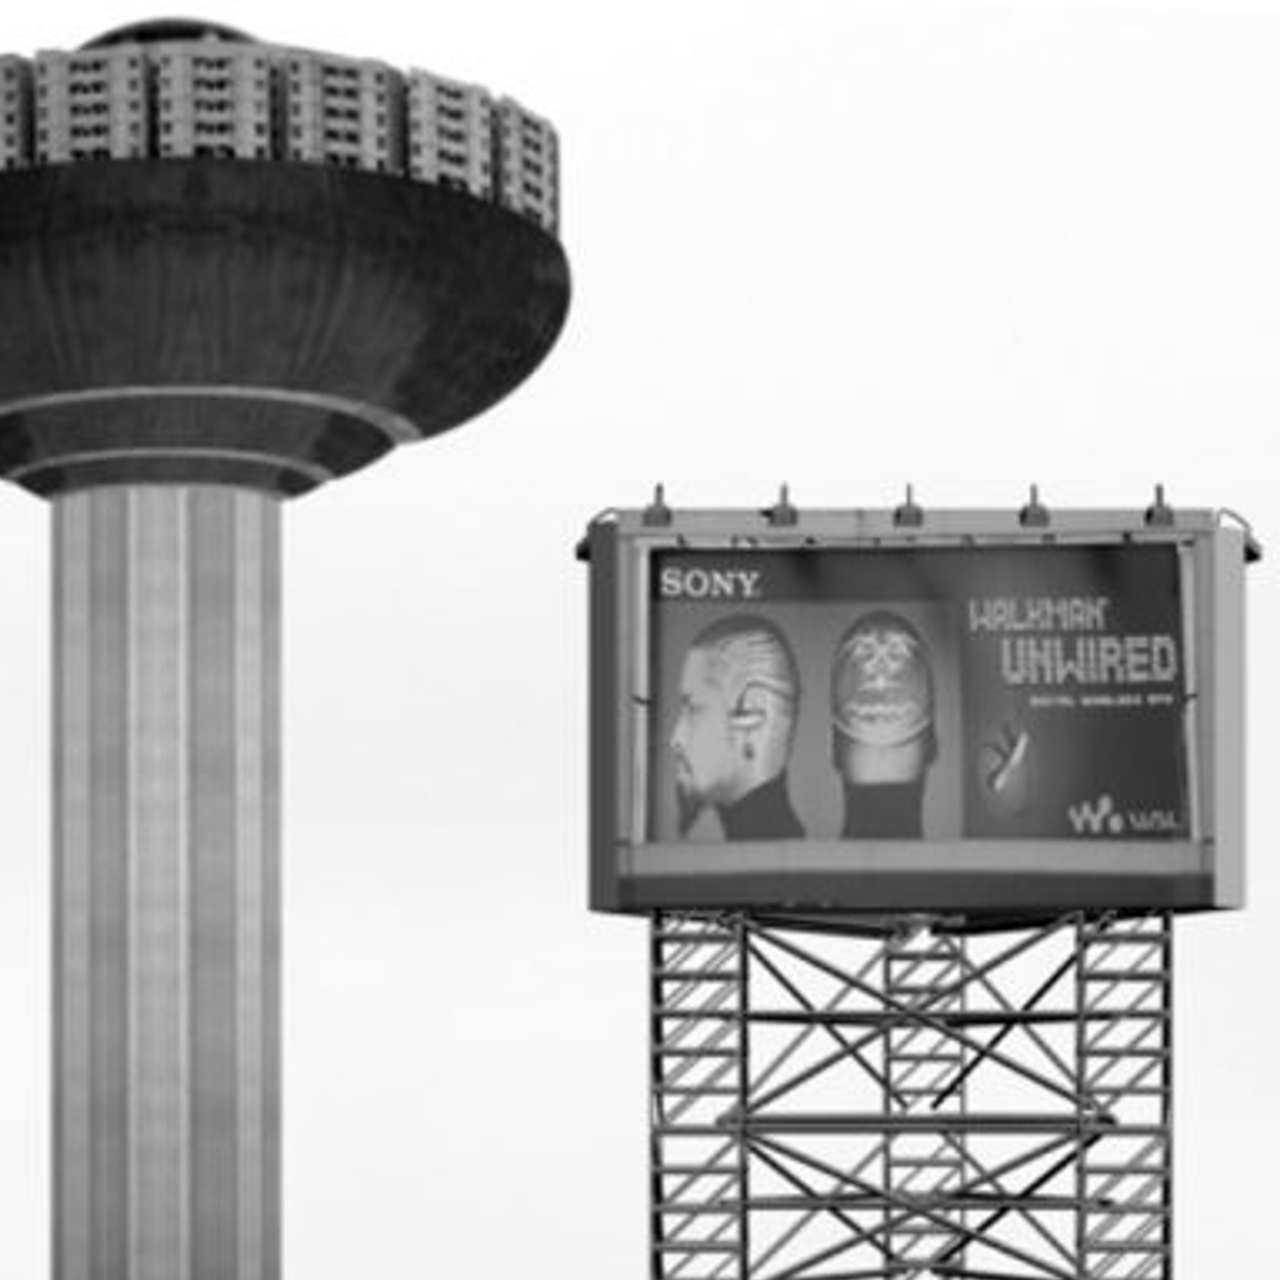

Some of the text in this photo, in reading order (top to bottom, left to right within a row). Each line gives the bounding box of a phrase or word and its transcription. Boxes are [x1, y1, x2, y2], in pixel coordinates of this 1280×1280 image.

[662, 567, 761, 598] SONY
[969, 596, 1109, 632] WALKMAN
[1001, 636, 1176, 685] UNWIRED
